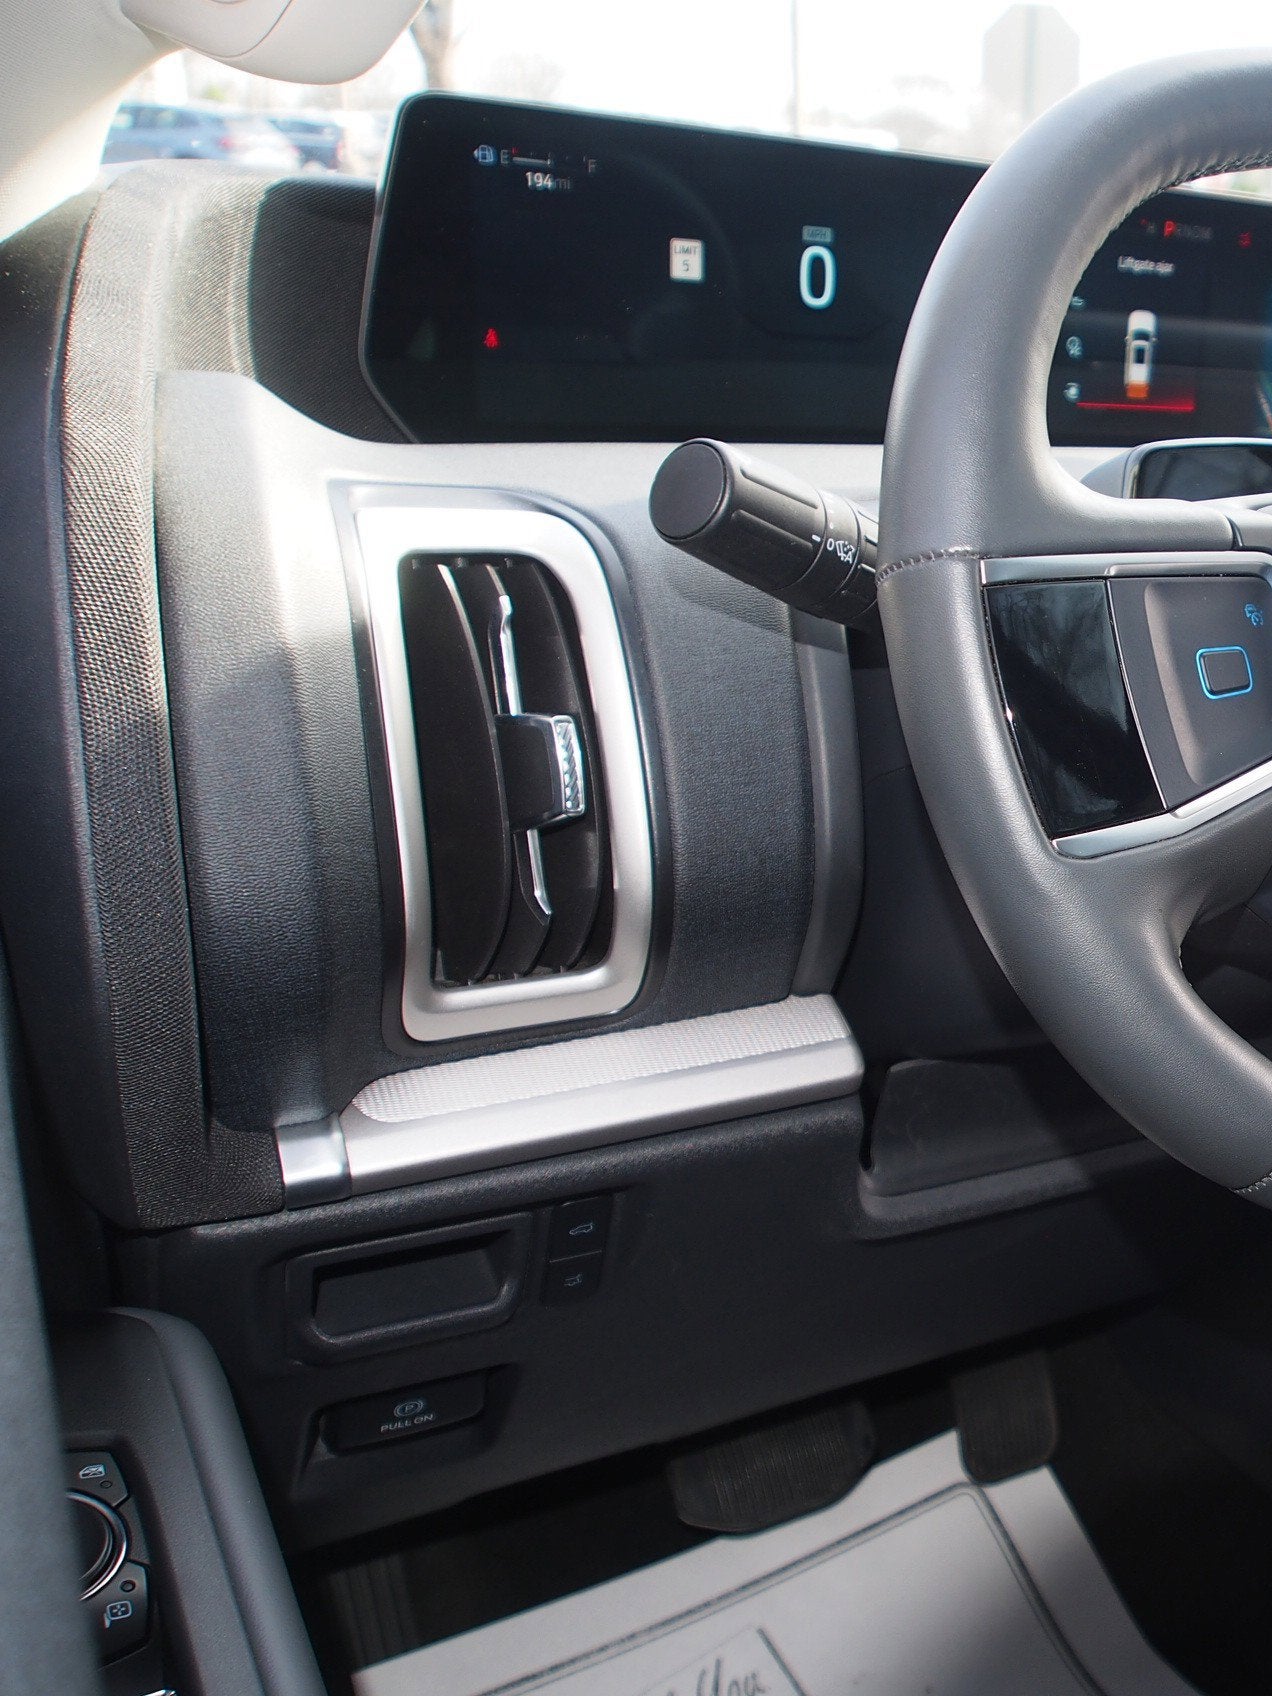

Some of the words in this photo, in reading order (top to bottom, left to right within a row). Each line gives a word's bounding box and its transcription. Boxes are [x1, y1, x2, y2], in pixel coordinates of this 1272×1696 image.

[525, 171, 553, 189] 194
[674, 245, 698, 255] LIMIT
[682, 259, 690, 272] 5
[800, 245, 836, 309] 0
[380, 1420, 412, 1432] PULL
[414, 1413, 434, 1424] ON
